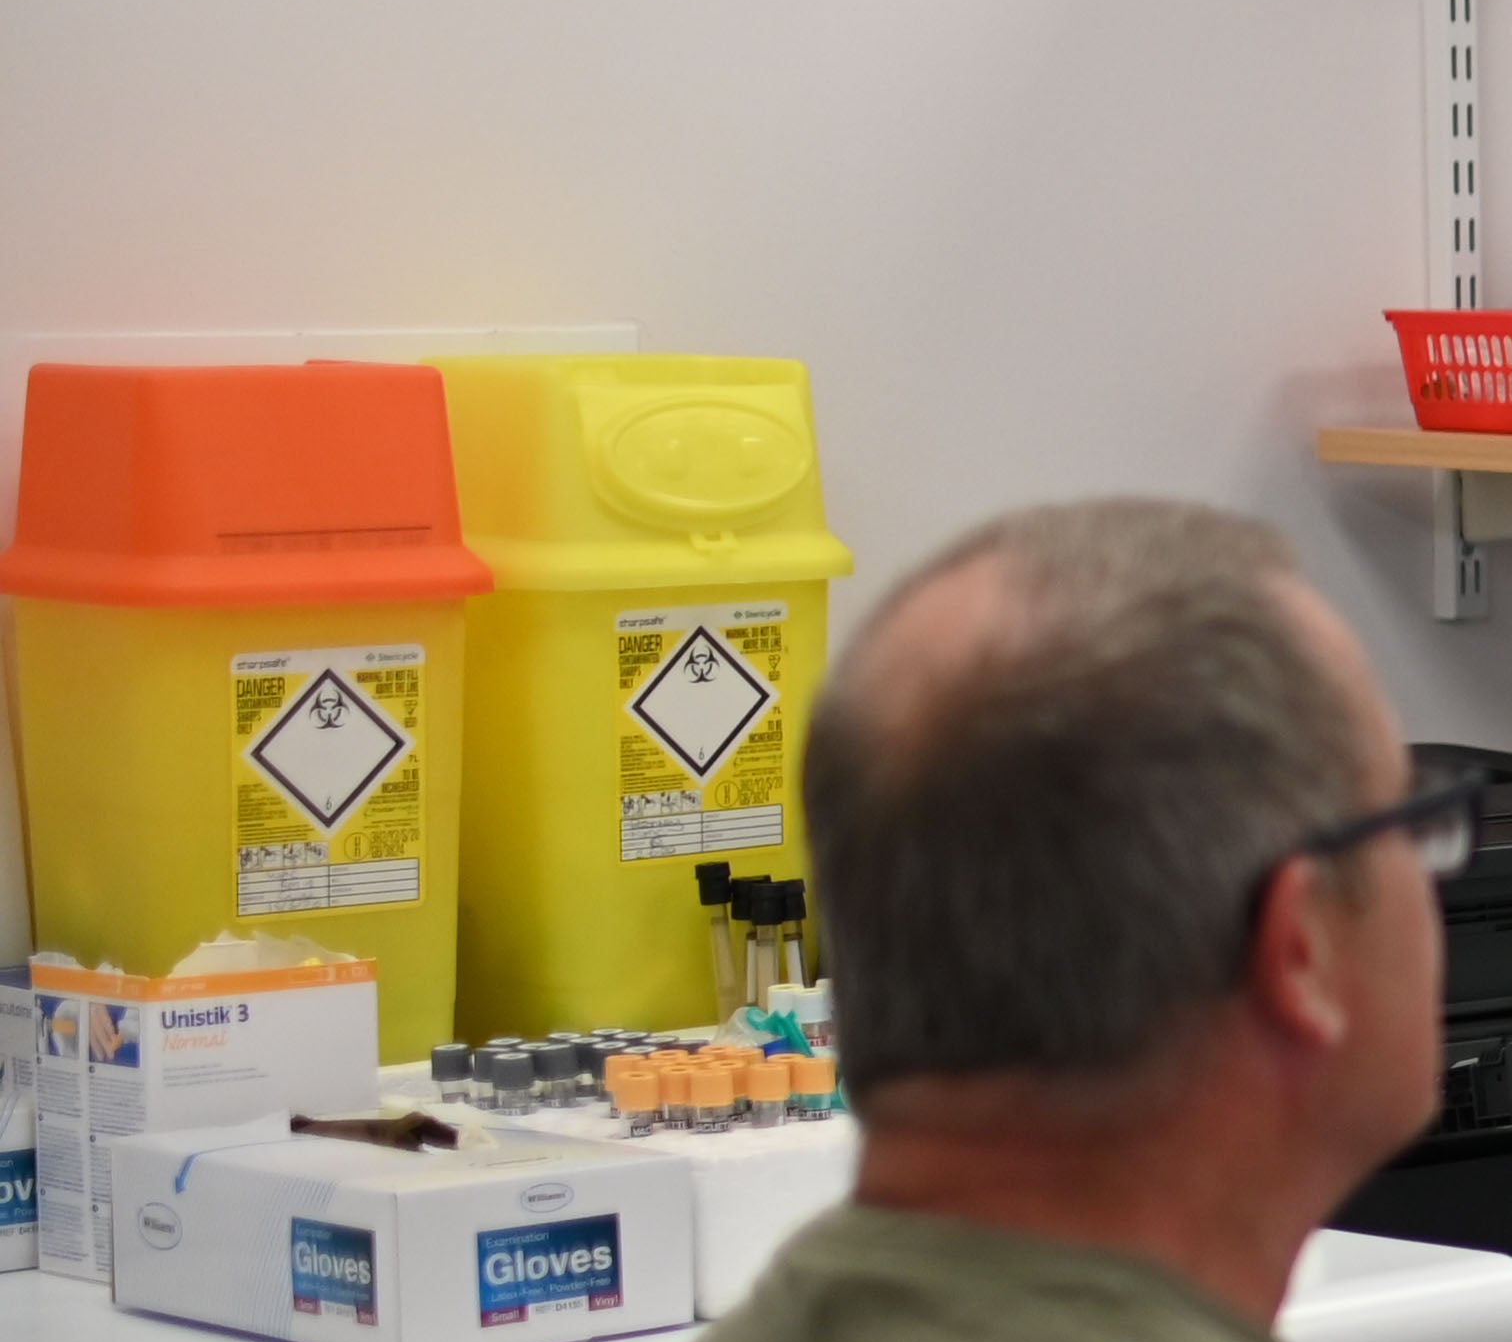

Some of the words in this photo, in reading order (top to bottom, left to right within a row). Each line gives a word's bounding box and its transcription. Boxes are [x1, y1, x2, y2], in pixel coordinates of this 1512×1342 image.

[619, 634, 662, 654] DANGER
[237, 677, 285, 697] DANGER
[699, 748, 704, 760] 6
[326, 797, 332, 810] 6
[161, 1006, 231, 1030] Unistik
[237, 1003, 250, 1023] 3
[162, 1030, 228, 1052] Normal
[486, 1231, 550, 1249] Examination
[295, 1241, 371, 1285] Gloves
[486, 1245, 613, 1287] Gloves
[594, 1294, 619, 1307] Vinyl
[491, 1309, 520, 1323] Small
